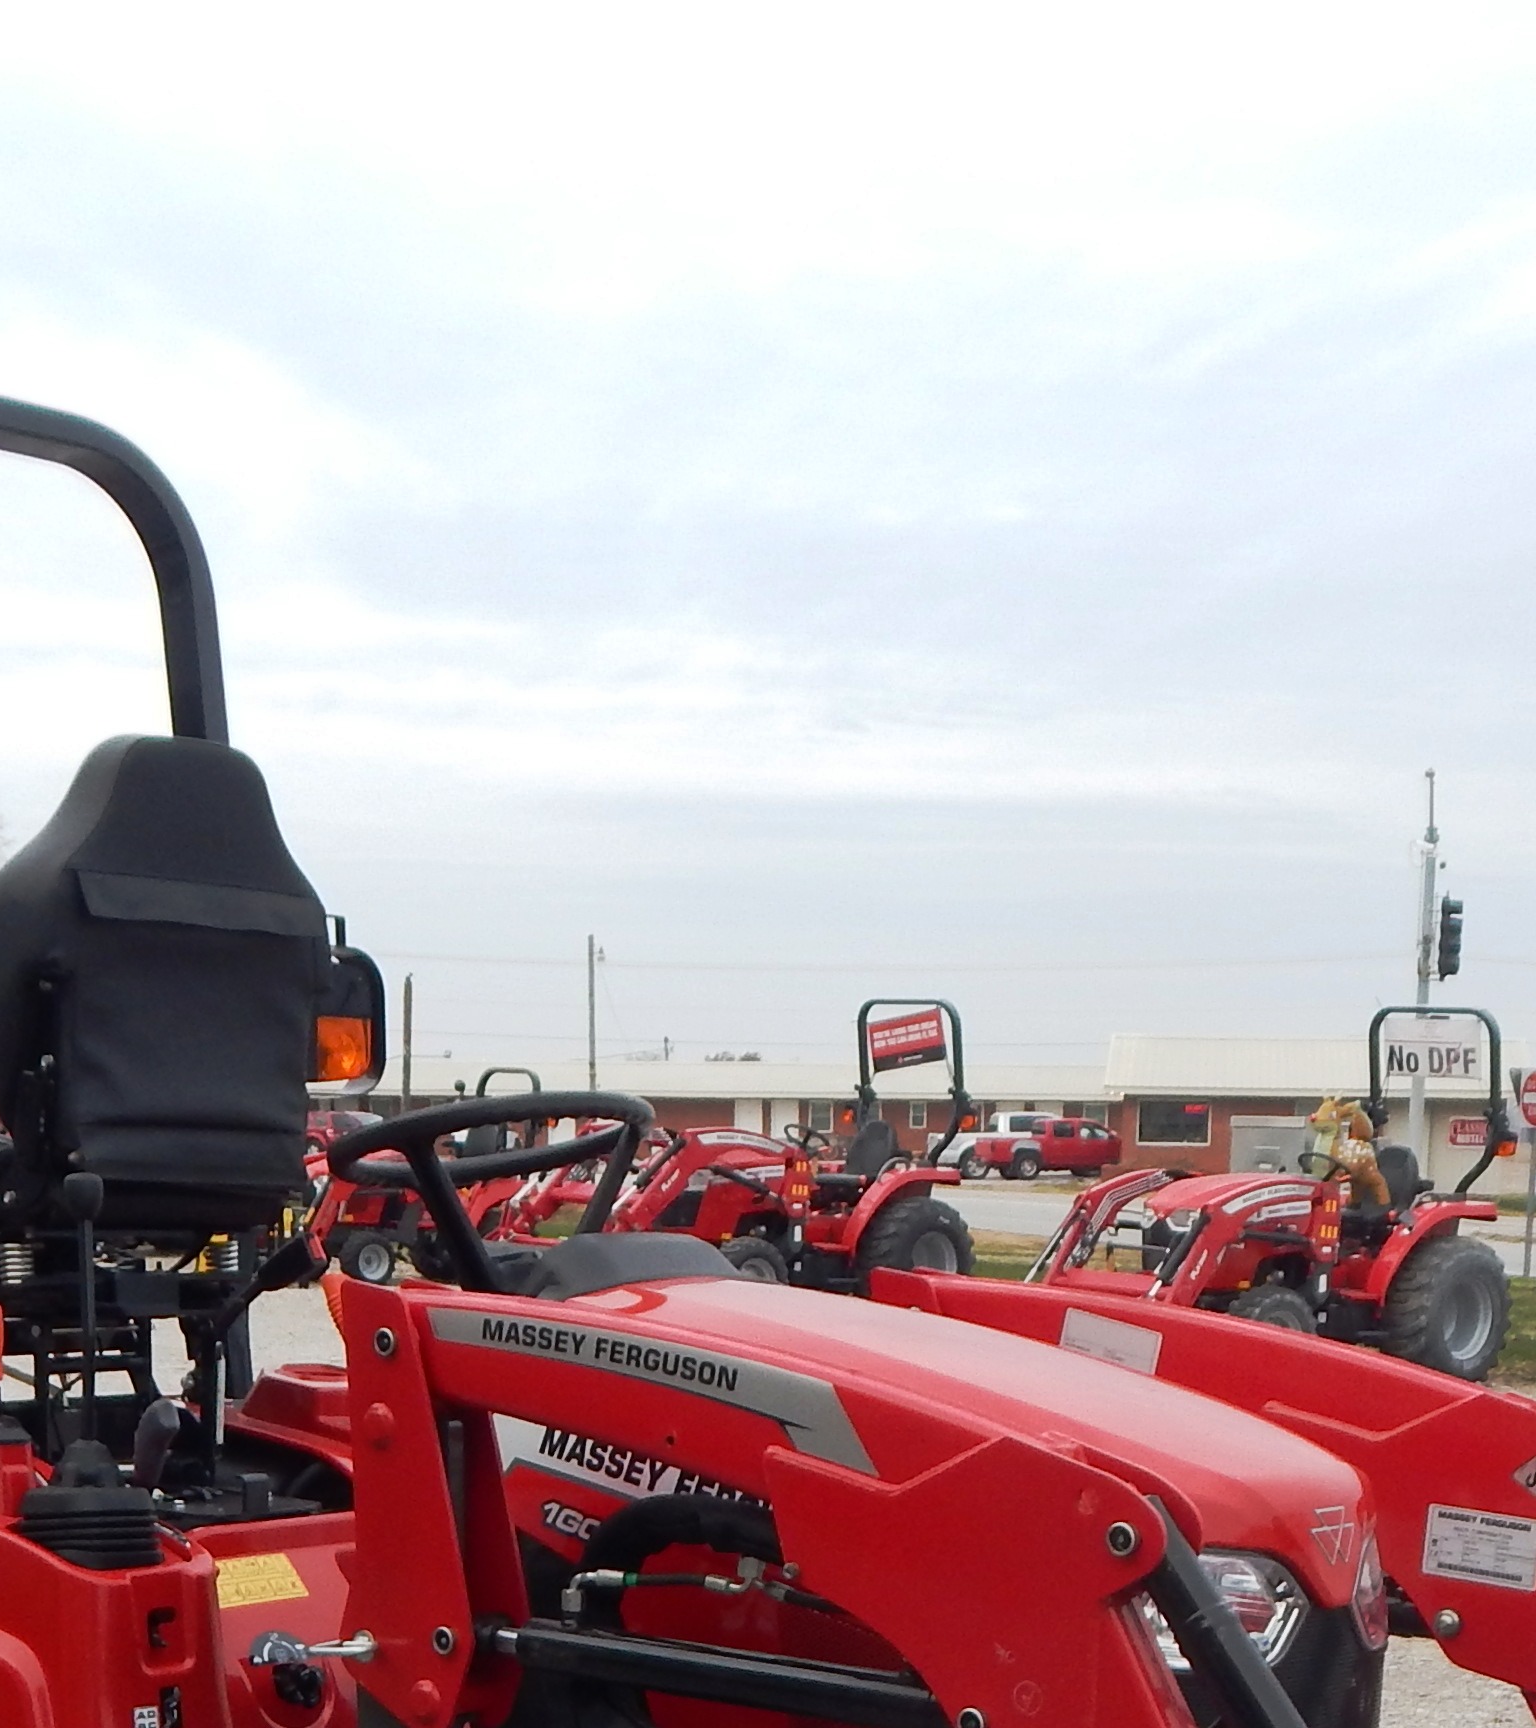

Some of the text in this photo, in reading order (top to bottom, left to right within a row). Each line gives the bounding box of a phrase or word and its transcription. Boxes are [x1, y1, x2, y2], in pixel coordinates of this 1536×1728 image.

[1388, 1045, 1477, 1074] No DPF
[481, 1318, 739, 1391] MASSEY FERGUSON
[538, 1426, 670, 1492] MASSEY
